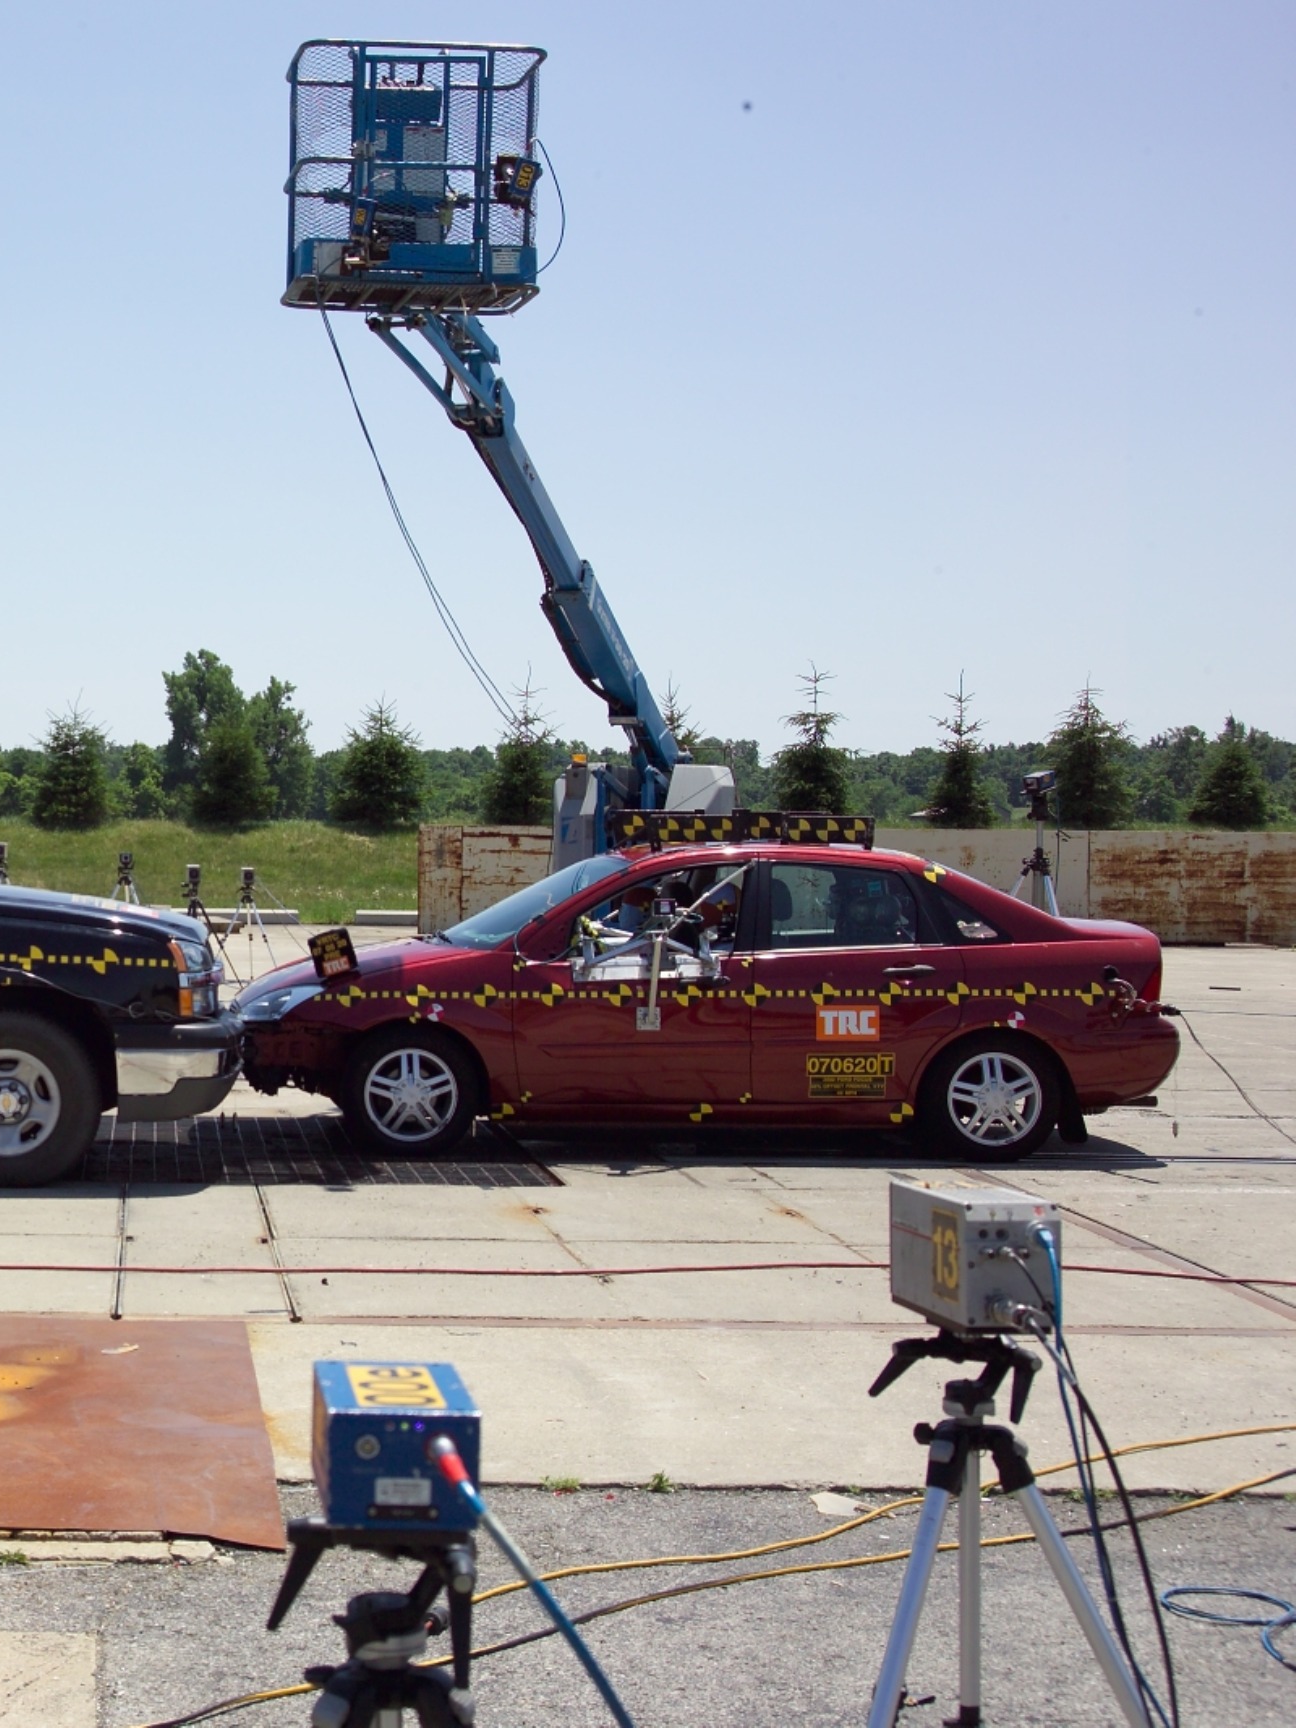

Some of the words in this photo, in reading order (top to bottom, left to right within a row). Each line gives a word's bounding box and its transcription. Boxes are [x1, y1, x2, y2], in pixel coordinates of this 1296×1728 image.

[323, 956, 350, 975] TRC
[819, 1009, 876, 1036] TRC
[932, 1224, 959, 1289] 13
